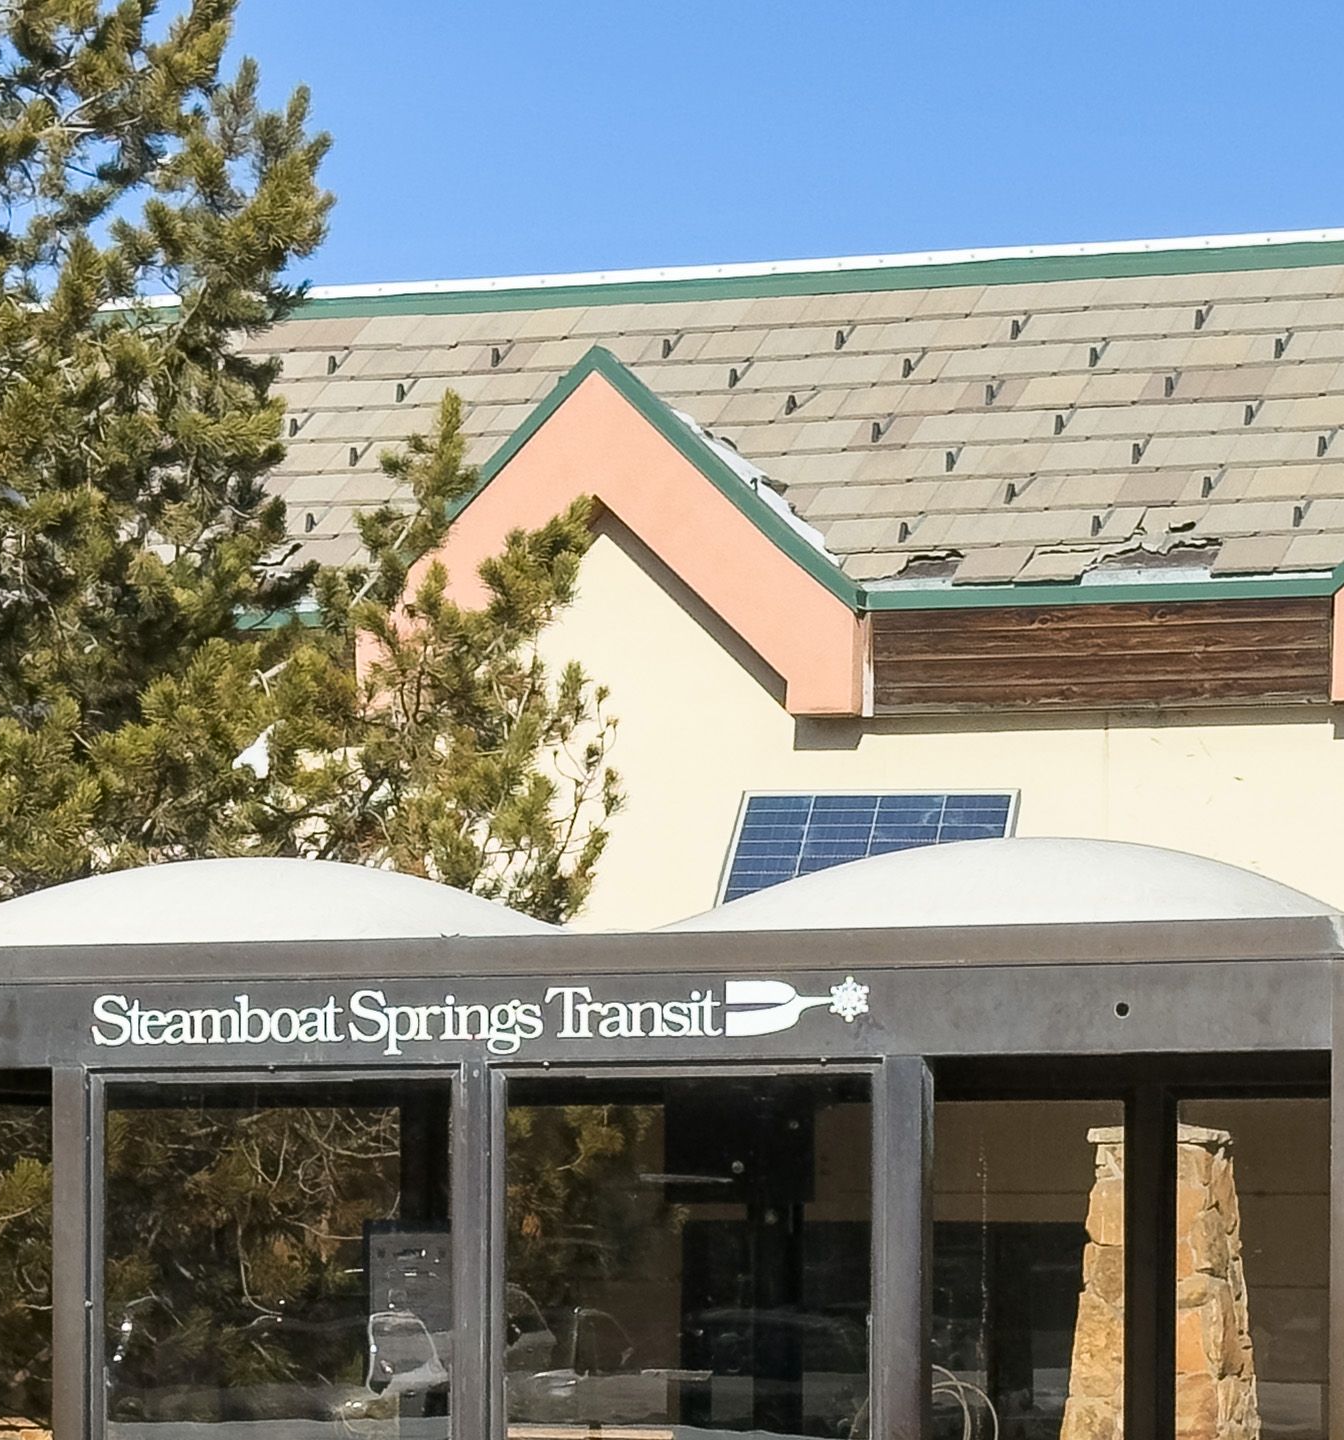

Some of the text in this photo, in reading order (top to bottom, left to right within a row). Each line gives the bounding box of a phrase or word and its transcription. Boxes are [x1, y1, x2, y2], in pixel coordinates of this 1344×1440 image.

[91, 986, 724, 1056] Steamboat Springs Transit
